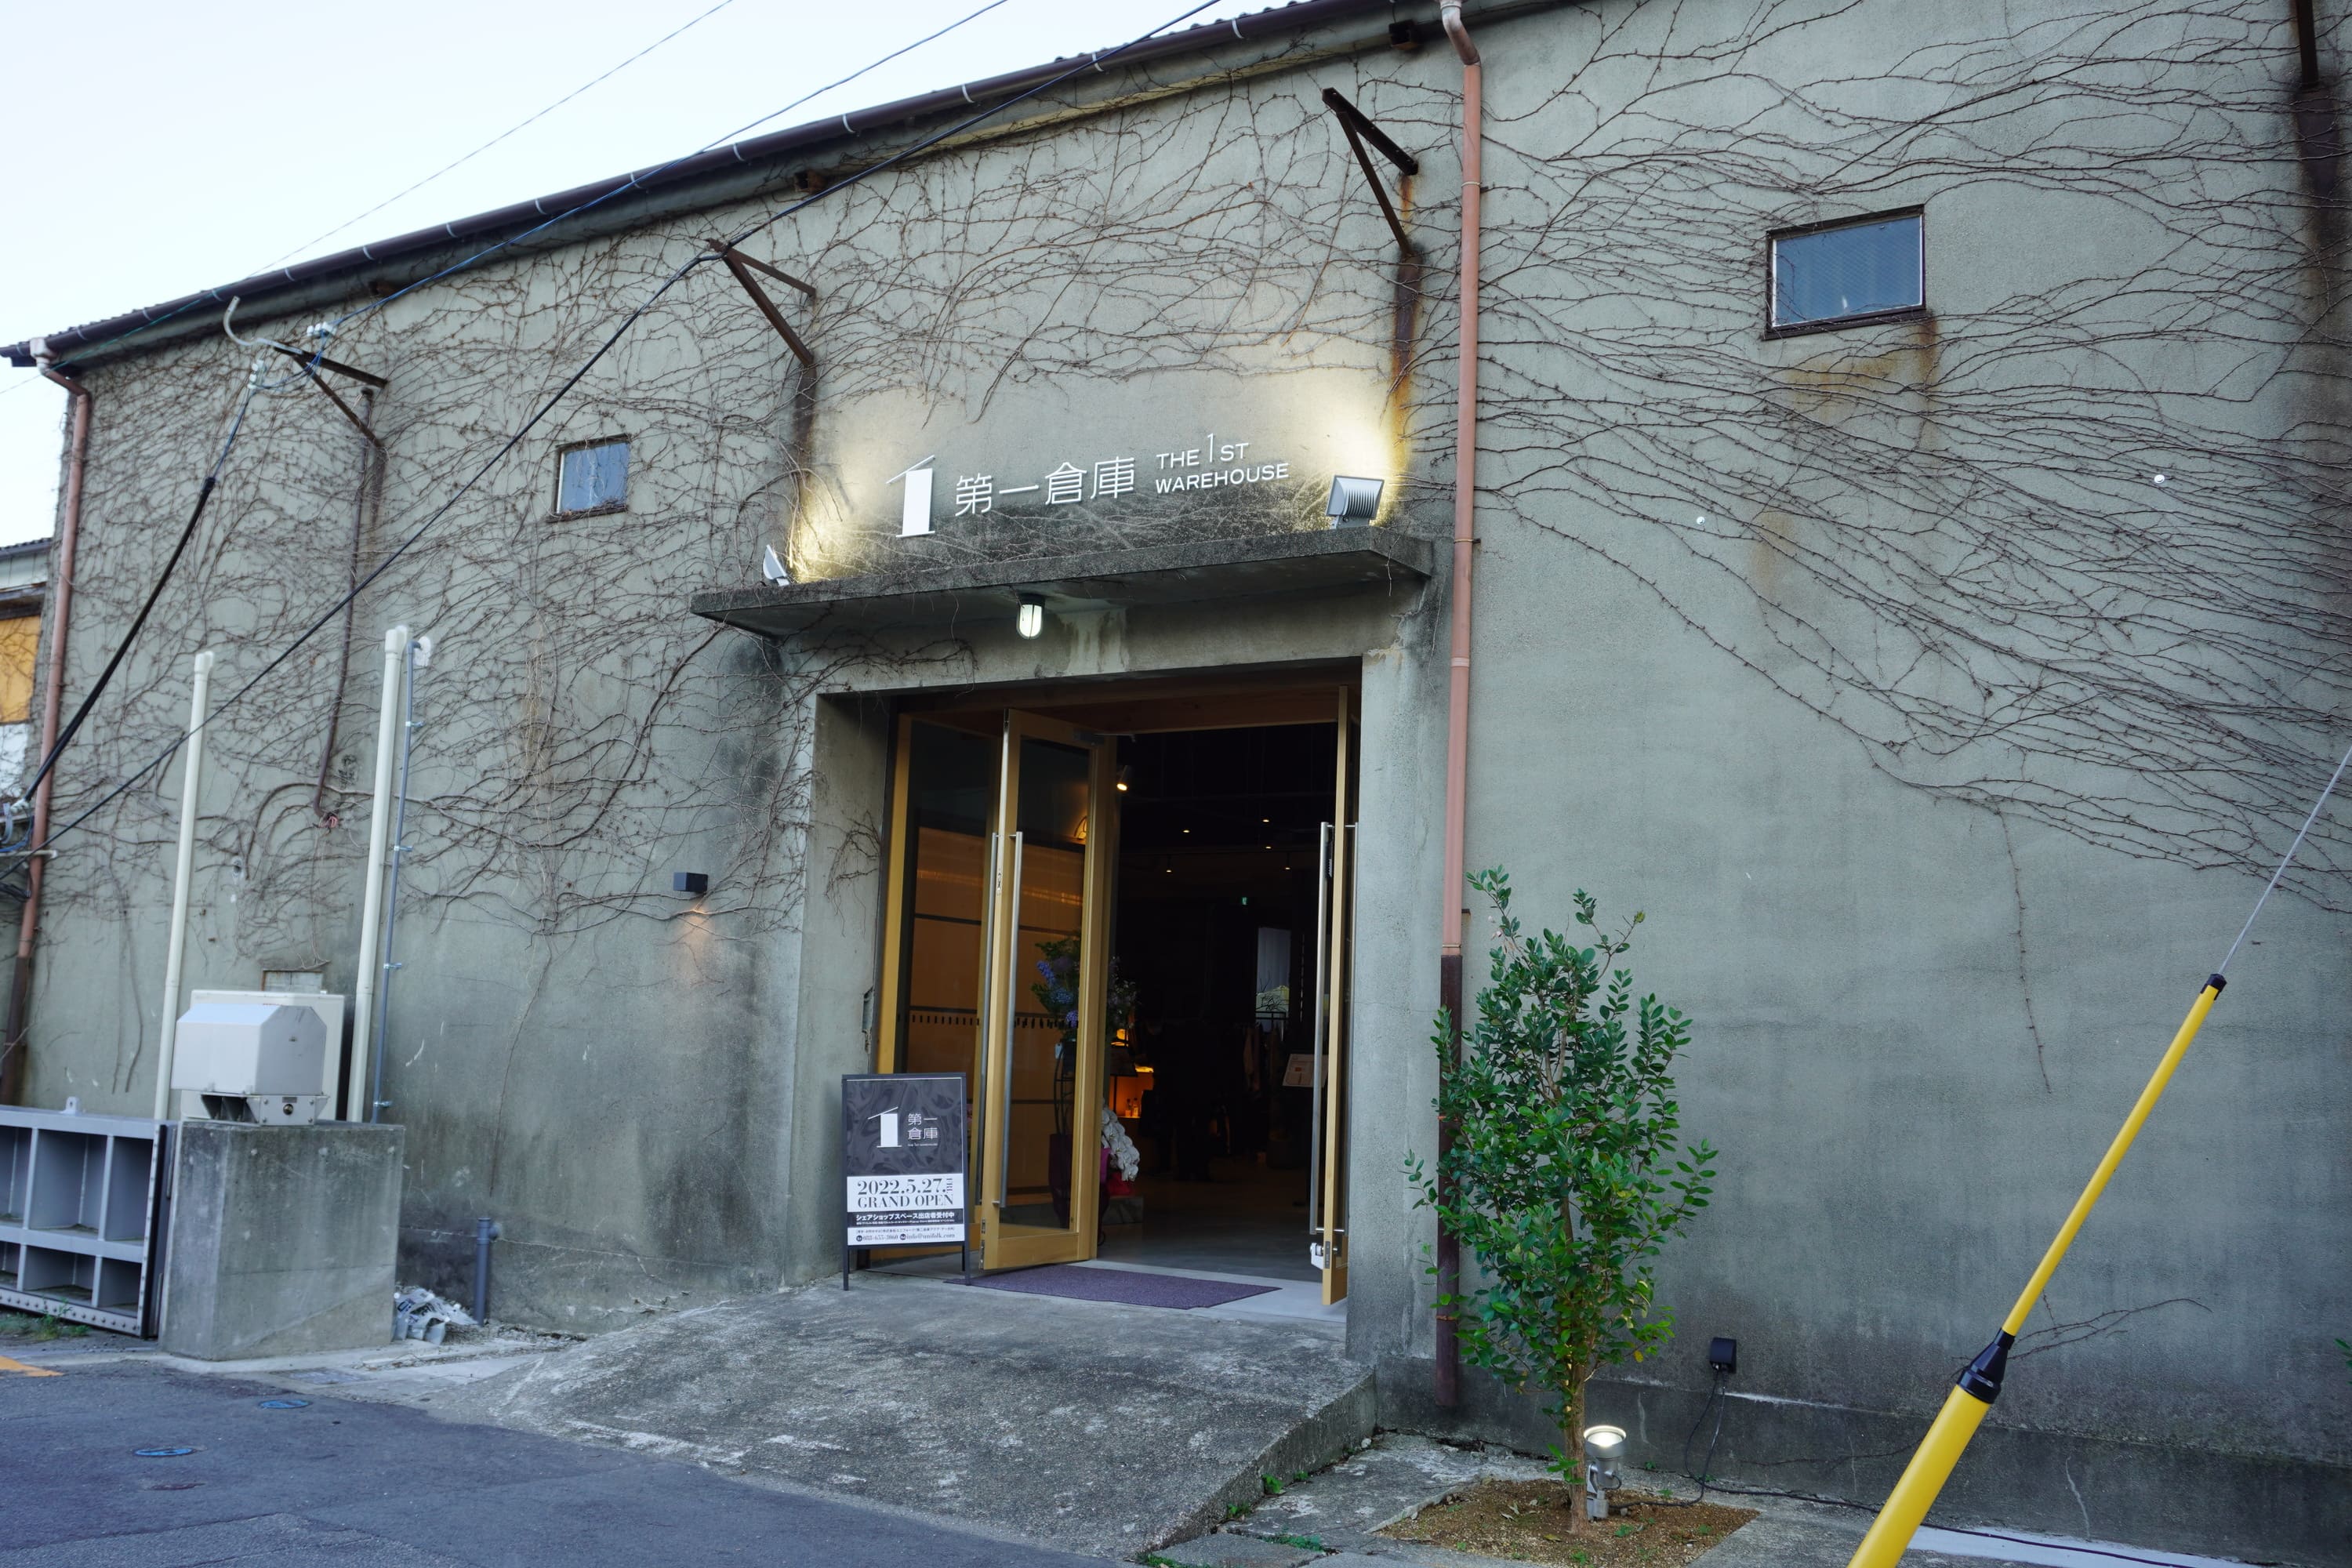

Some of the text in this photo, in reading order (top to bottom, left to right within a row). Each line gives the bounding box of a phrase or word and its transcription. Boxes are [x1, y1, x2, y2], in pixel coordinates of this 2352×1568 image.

[1156, 433, 1250, 470] THE 1ST
[955, 456, 1135, 517] 第一倉庫
[1155, 463, 1290, 494] WAREHOUSE
[908, 1113, 938, 1126] 第一
[907, 1127, 938, 1140] 倉庫
[858, 1194, 953, 1208] GRAND OPEN
